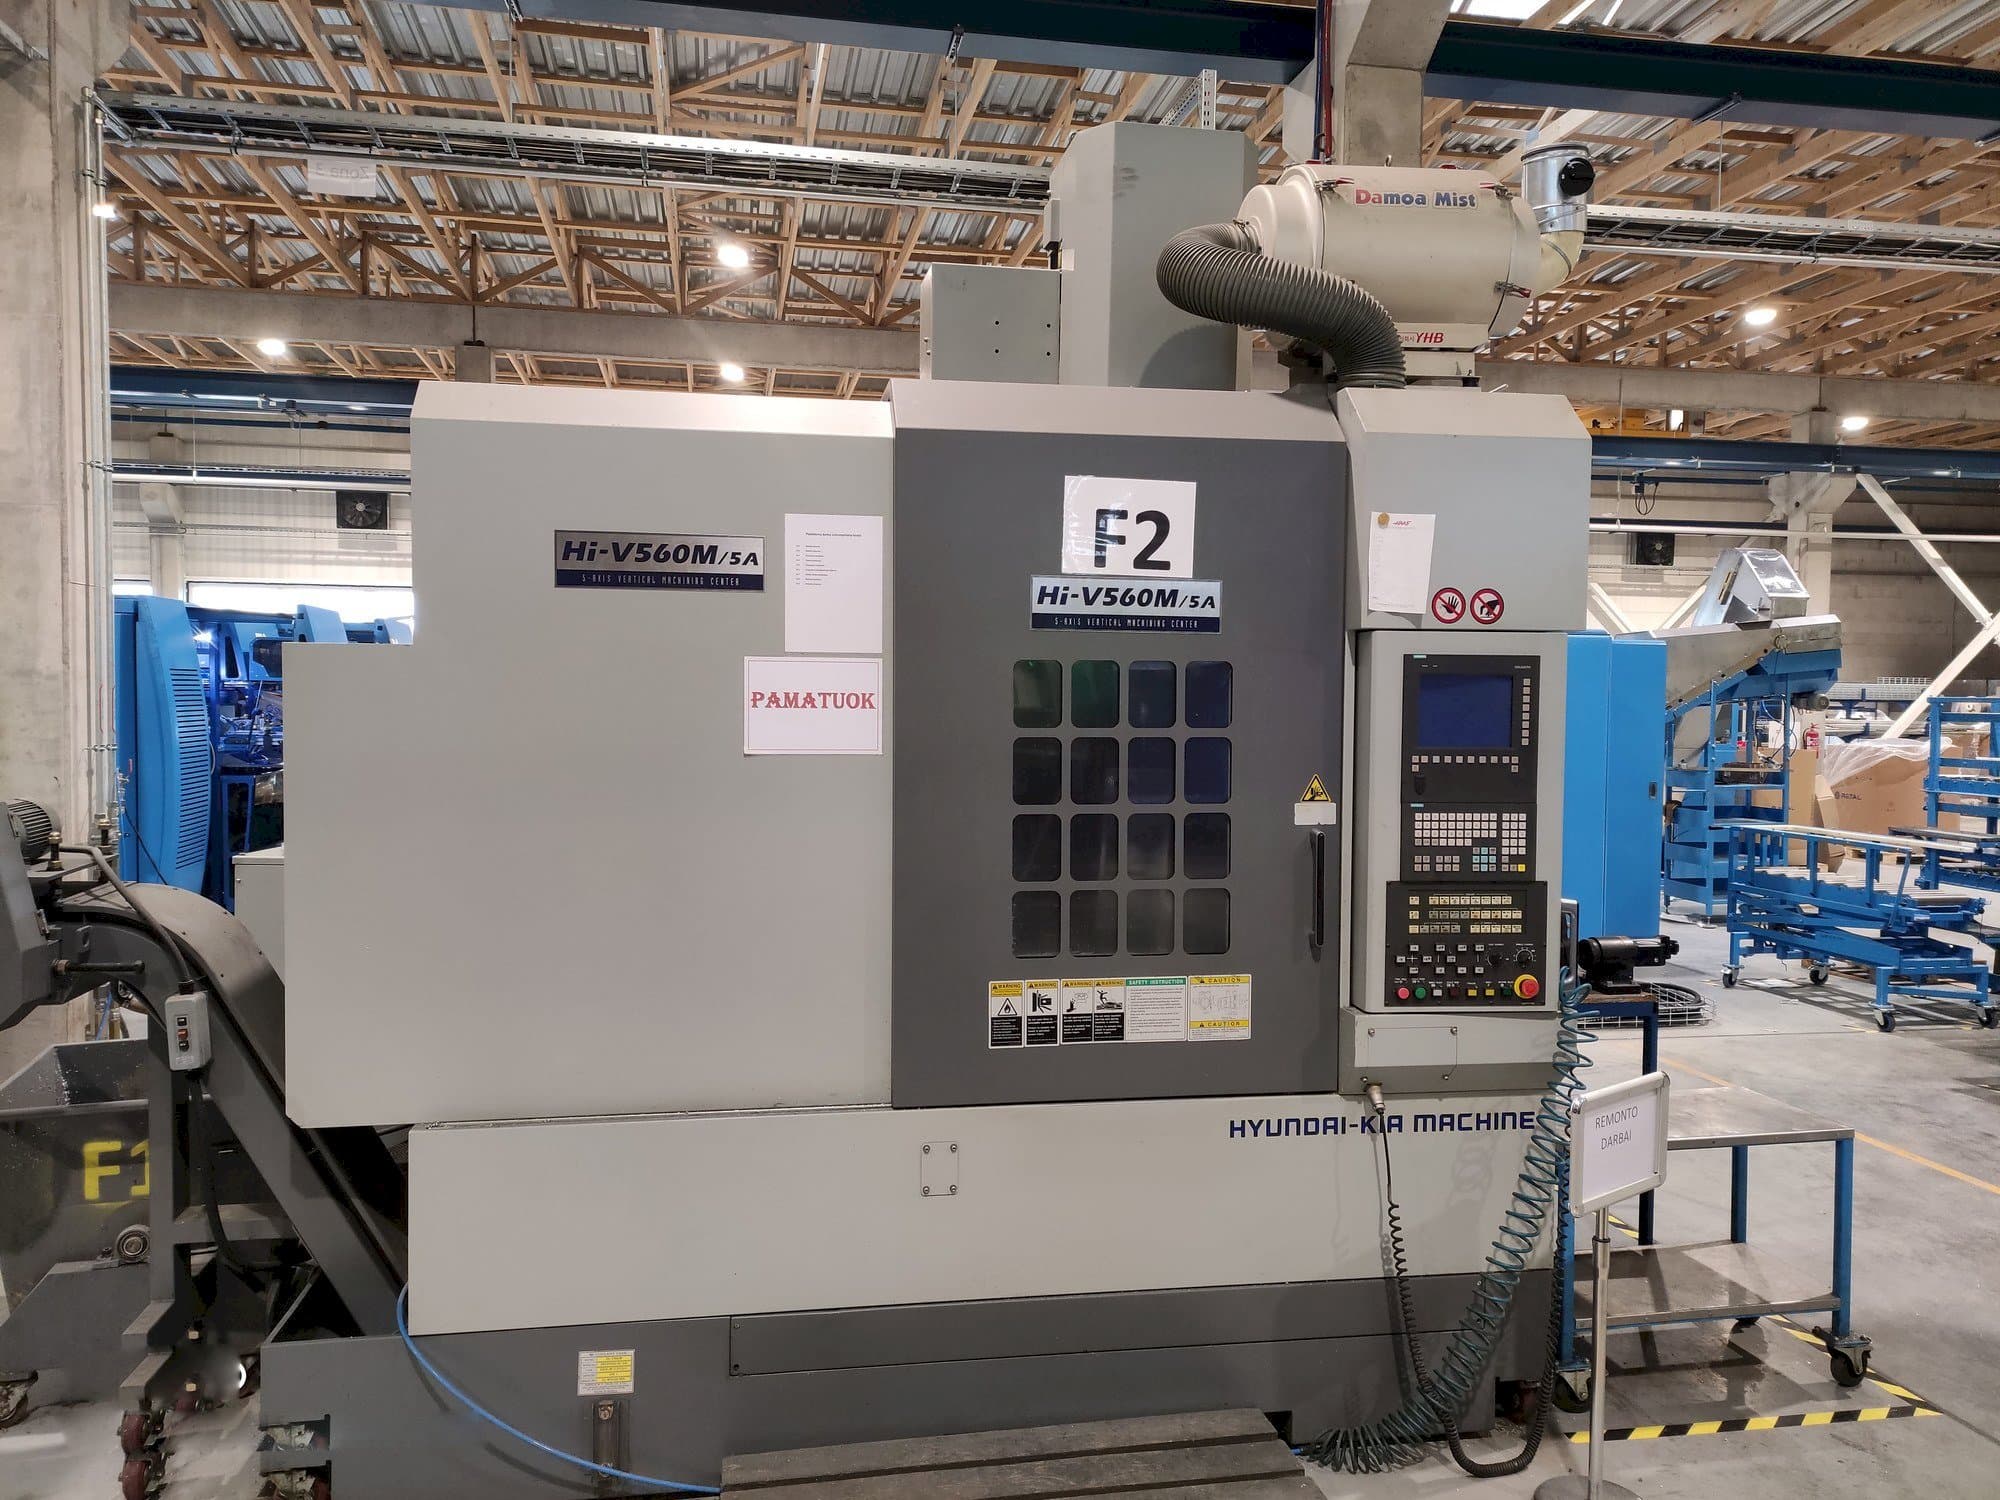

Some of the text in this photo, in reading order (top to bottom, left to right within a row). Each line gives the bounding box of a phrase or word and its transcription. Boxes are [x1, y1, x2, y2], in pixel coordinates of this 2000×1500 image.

[1355, 189, 1476, 207] Damoa Mist
[1416, 332, 1444, 343] YHB
[1094, 508, 1171, 571] F2
[561, 540, 759, 567] Hi-V560M/5A
[582, 574, 740, 587] 5-AXIS VERTICAL MACHINING CENTER
[1037, 585, 1215, 609] Hi-V560M/5A
[1055, 617, 1198, 629] 5-AXIS VERTICAL MACHINING CENTER
[751, 691, 876, 710] PAMATUOK
[1413, 1111, 1536, 1133] MACHINE
[1595, 1105, 1639, 1129] REMONTO
[1601, 1129, 1632, 1150] DARBAI
